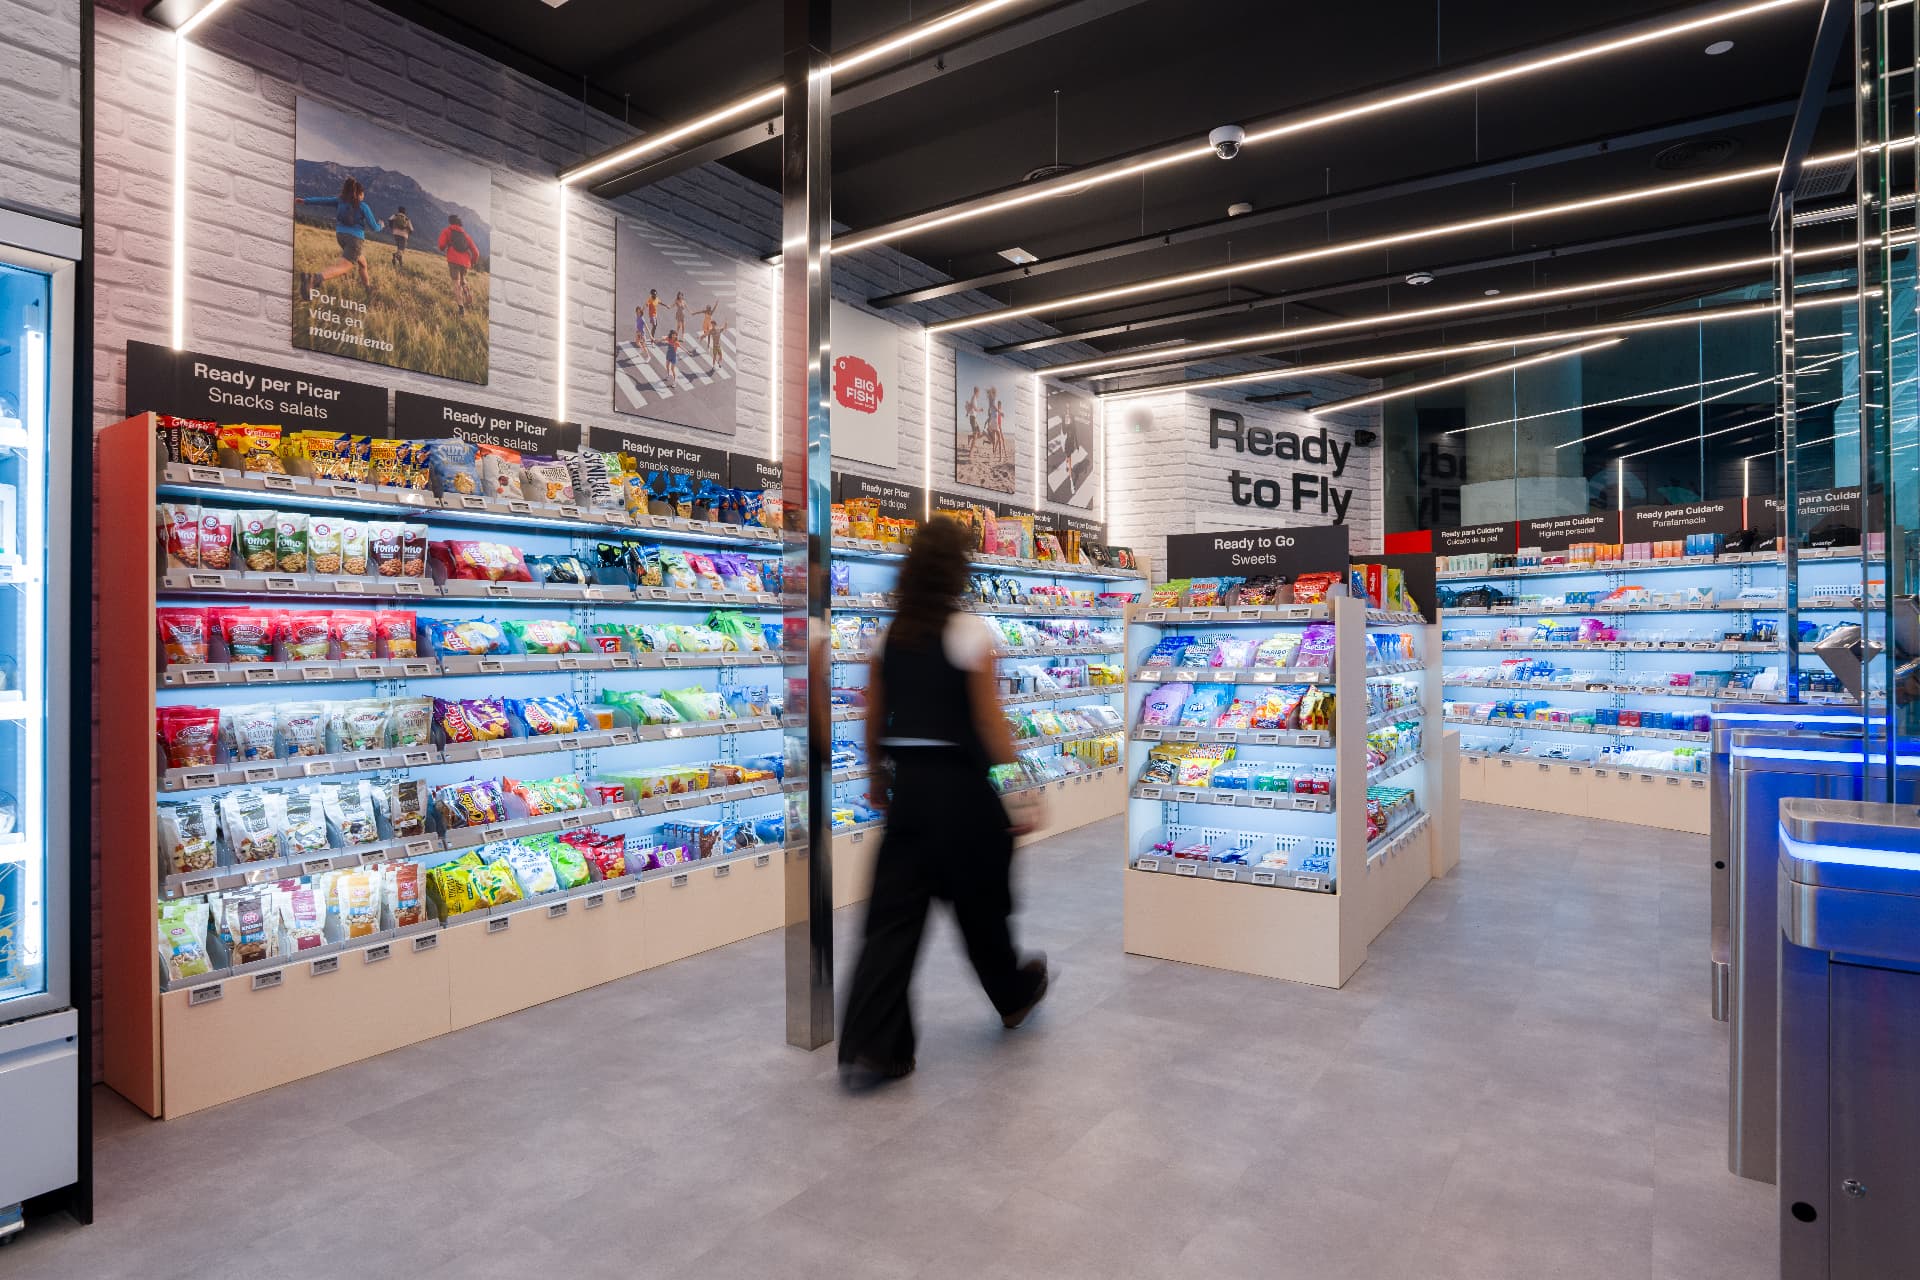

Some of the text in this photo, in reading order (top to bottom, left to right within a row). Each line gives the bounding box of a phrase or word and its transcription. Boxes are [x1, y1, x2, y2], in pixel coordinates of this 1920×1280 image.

[310, 288, 367, 314] Por una
[309, 308, 363, 330] vida en
[309, 326, 394, 352] movimiento
[194, 362, 340, 402] Ready per Picar
[854, 377, 874, 392] BIG
[208, 387, 328, 419] Snacks salats
[846, 386, 874, 404] FISH
[443, 407, 548, 436] Ready per Picar
[453, 427, 538, 452] Snacks salats
[1210, 408, 1350, 478] Ready
[309, 450, 342, 460] EAGLE
[622, 439, 702, 463] Ready per Picar
[640, 460, 720, 481] snacks sense gluten
[756, 463, 782, 479] Ready
[861, 482, 910, 499] Ready per Picar
[1228, 470, 1352, 526] to Fly
[1798, 495, 1822, 506] para
[1824, 491, 1861, 502] Cuidar
[940, 496, 956, 508] Ready
[956, 500, 966, 508] per
[1636, 504, 1724, 520] Ready para Cuidarte
[1531, 516, 1604, 530] Ready para Cuidarte
[1652, 516, 1706, 528] Parafarmacia
[1441, 526, 1504, 539] Ready para Cuidarte
[1539, 526, 1596, 538] Higiene personal
[1214, 535, 1295, 550] Ready to Go
[1232, 553, 1277, 566] Sweets
